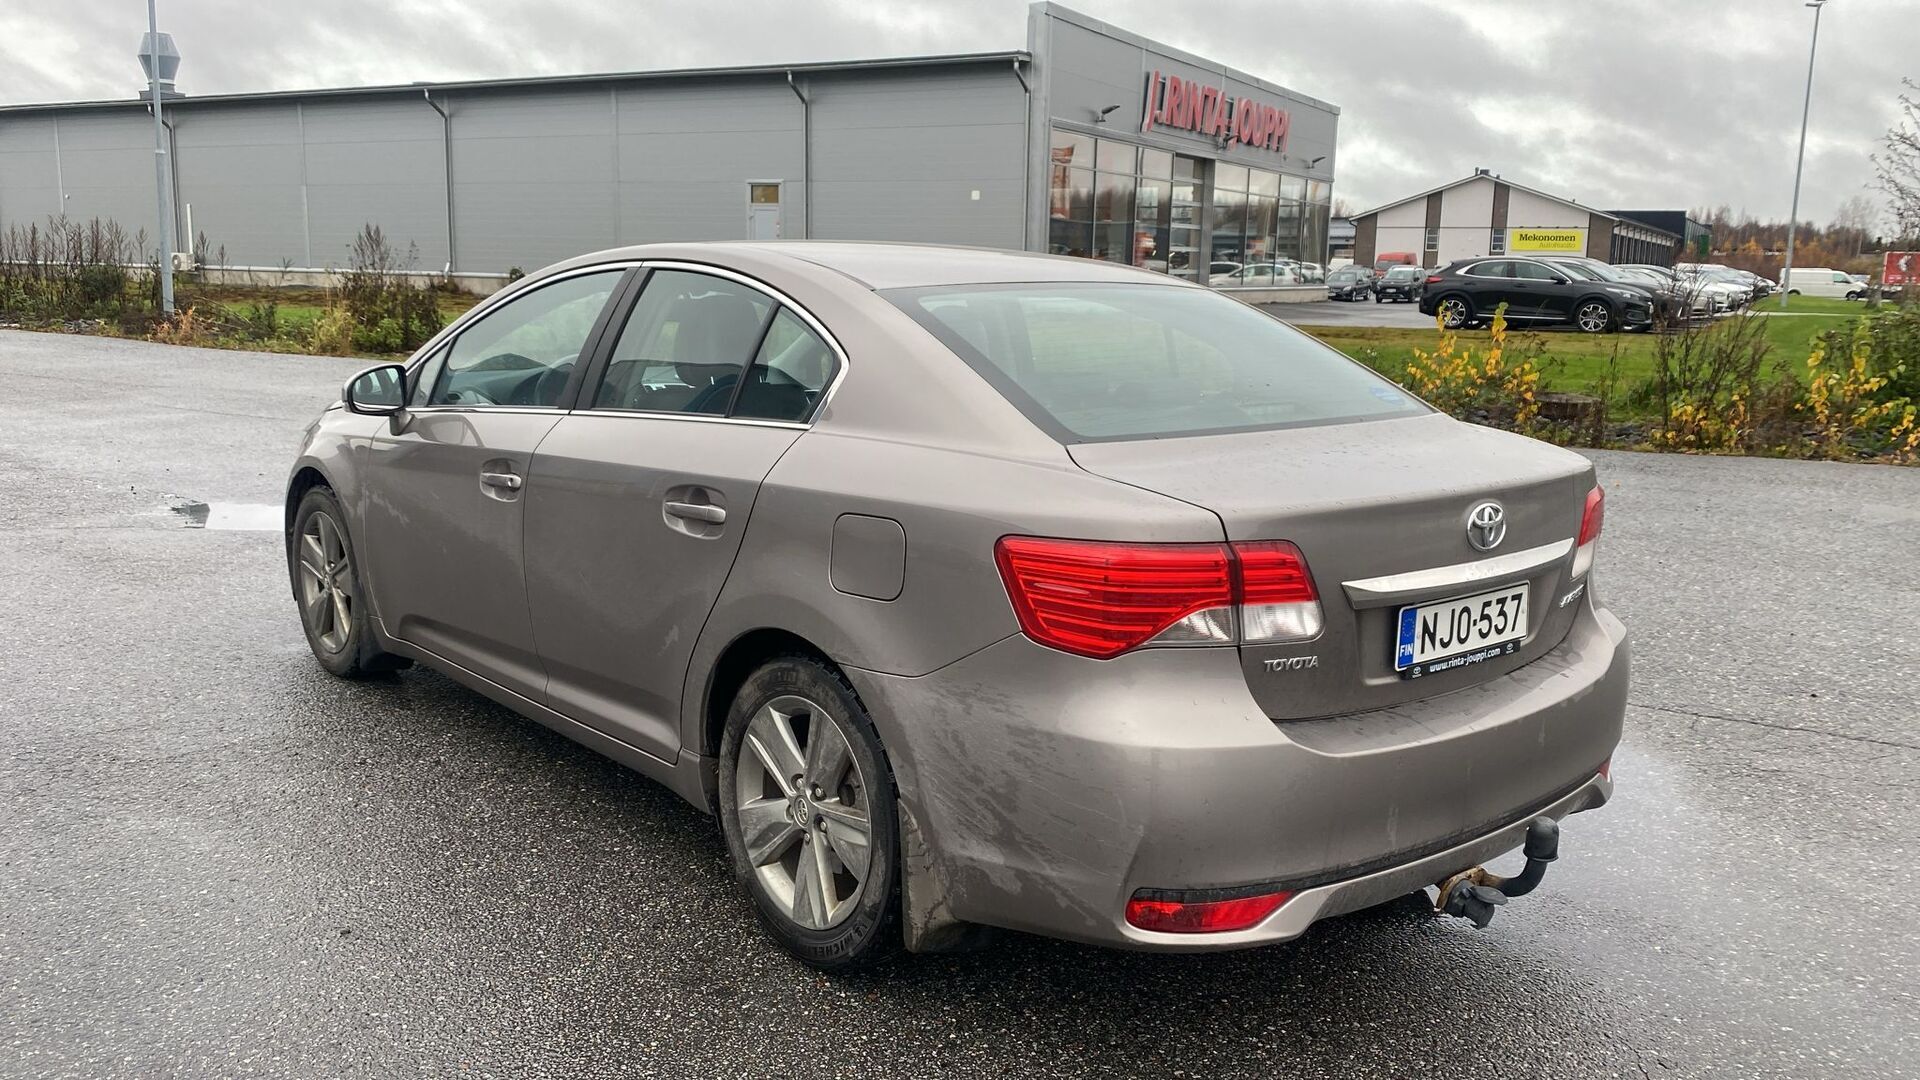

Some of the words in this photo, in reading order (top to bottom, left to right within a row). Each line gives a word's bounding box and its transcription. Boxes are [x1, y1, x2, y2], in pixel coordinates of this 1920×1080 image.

[1519, 233, 1576, 242] Mekonomen
[1420, 592, 1523, 655] NJO-537
[1399, 642, 1414, 657] FIN
[1264, 655, 1319, 672] TOYOTA
[1429, 647, 1501, 673] www.rinta-jouppi.com
